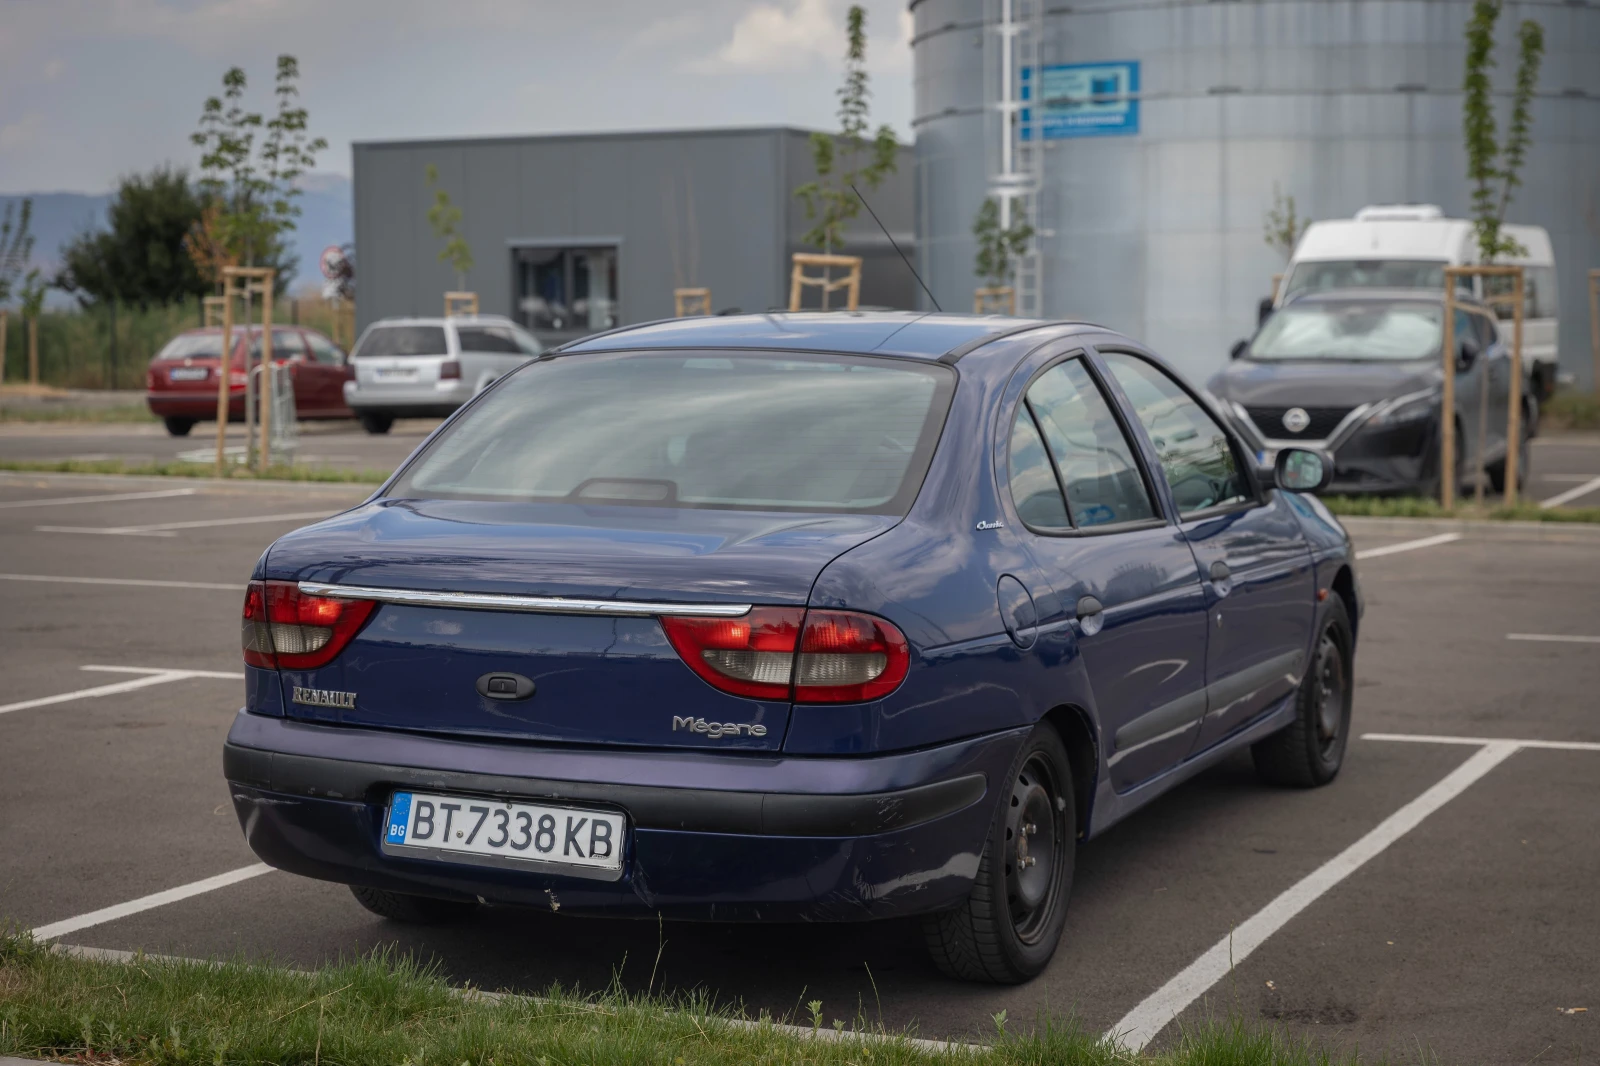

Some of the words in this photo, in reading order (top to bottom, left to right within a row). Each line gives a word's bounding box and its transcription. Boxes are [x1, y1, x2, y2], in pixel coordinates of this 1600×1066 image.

[292, 686, 357, 710] RENAULT
[672, 715, 767, 738] Mégane
[389, 824, 405, 837] BG
